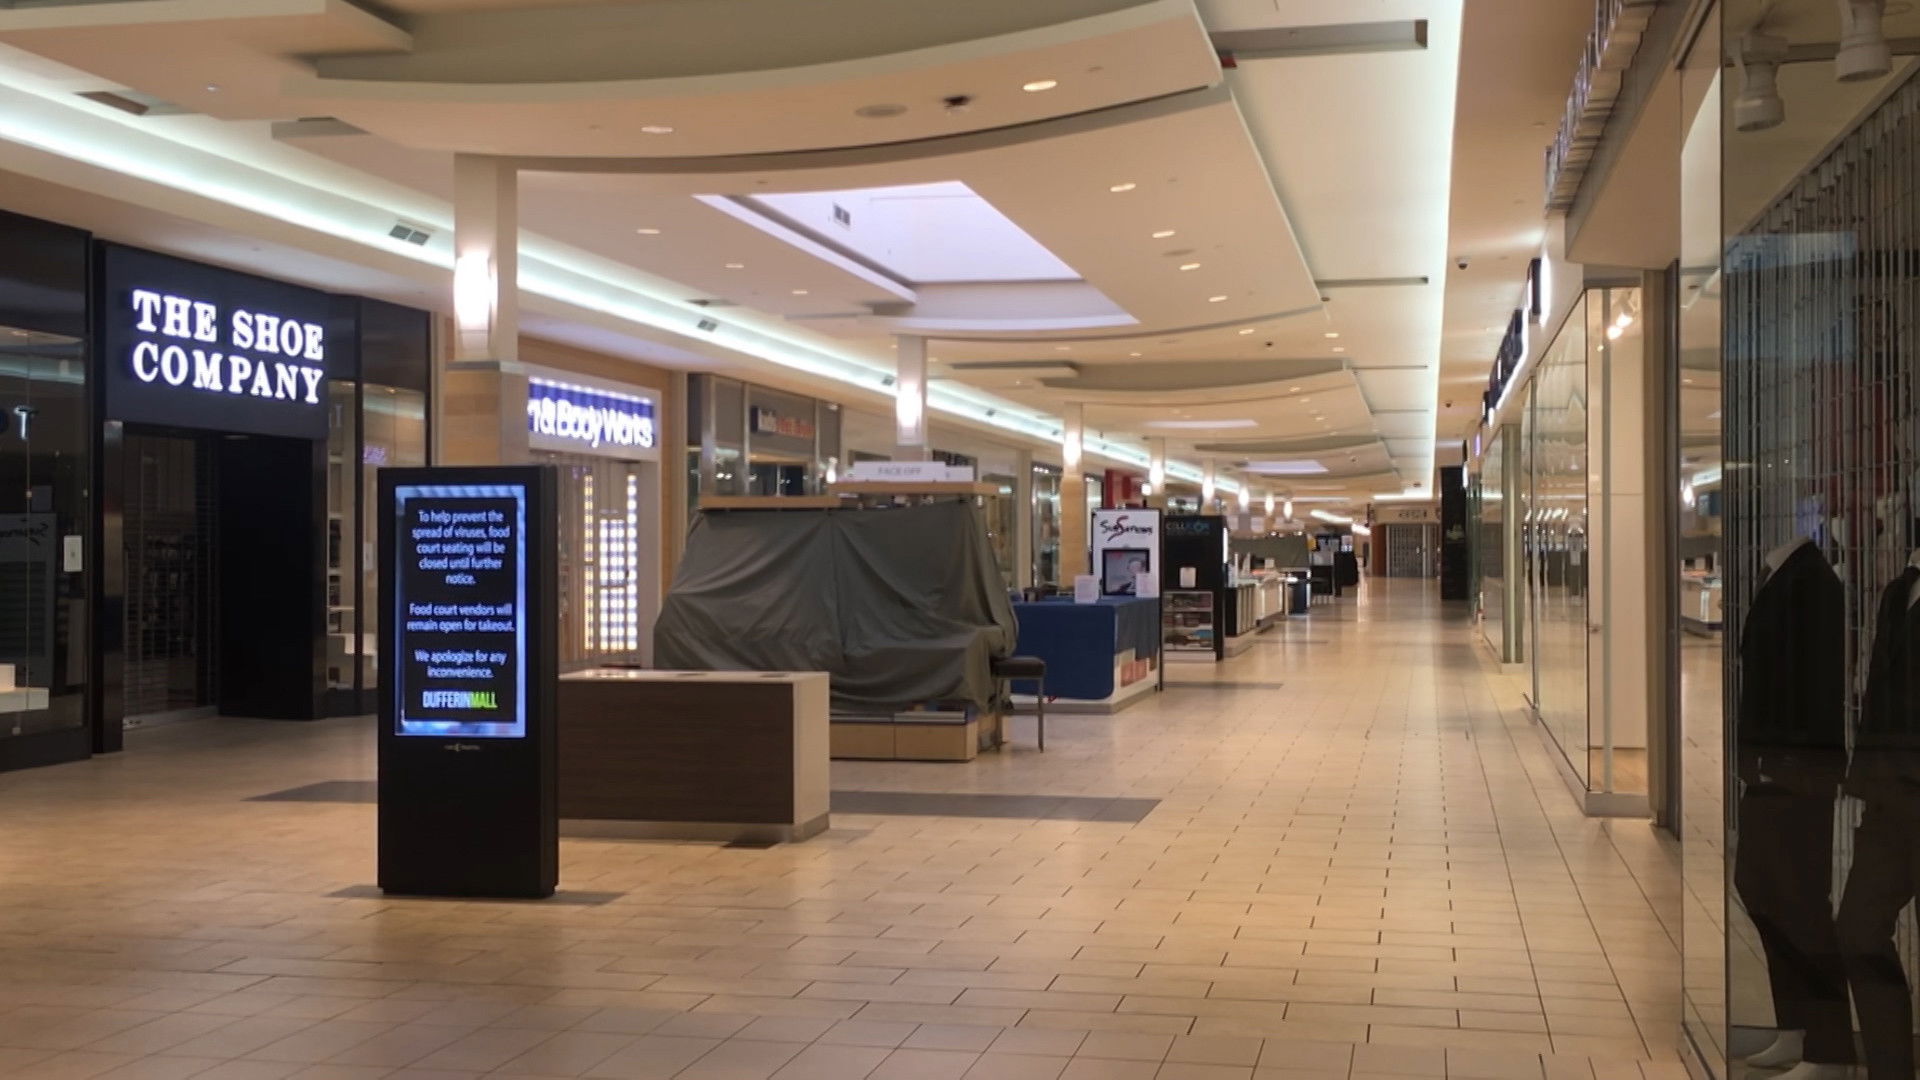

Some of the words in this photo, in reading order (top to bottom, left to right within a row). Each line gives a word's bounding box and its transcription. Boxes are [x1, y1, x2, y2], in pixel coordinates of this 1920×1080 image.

[133, 288, 217, 343] THE
[232, 309, 323, 361] SHOE
[133, 341, 323, 404] COMPANY
[556, 399, 602, 448] Body
[602, 407, 653, 448] Works
[418, 510, 429, 522] To
[430, 509, 451, 524] help
[452, 511, 487, 524] prevent
[488, 510, 504, 522] the
[412, 526, 443, 541] spread
[443, 526, 455, 538] of
[454, 527, 487, 539] viruses,
[488, 525, 510, 538] food
[416, 542, 441, 554] court
[442, 542, 475, 556] seating
[476, 541, 492, 554] will
[493, 541, 506, 554] be
[418, 557, 448, 569] closed
[449, 557, 471, 569] until
[471, 556, 503, 569] further
[445, 573, 476, 585] notice.
[410, 602, 433, 616] Food
[433, 604, 458, 616] court
[459, 603, 495, 616] vendors
[496, 602, 512, 616] will
[407, 619, 437, 631] remain
[439, 621, 462, 633] open
[463, 618, 477, 631] for
[478, 620, 515, 632] takeout.
[414, 649, 430, 662] We
[431, 650, 474, 665] apologize
[475, 649, 488, 662] for
[489, 652, 507, 666] any
[427, 665, 495, 679] inconvenience.
[422, 690, 499, 709] DUFFERINMALL
